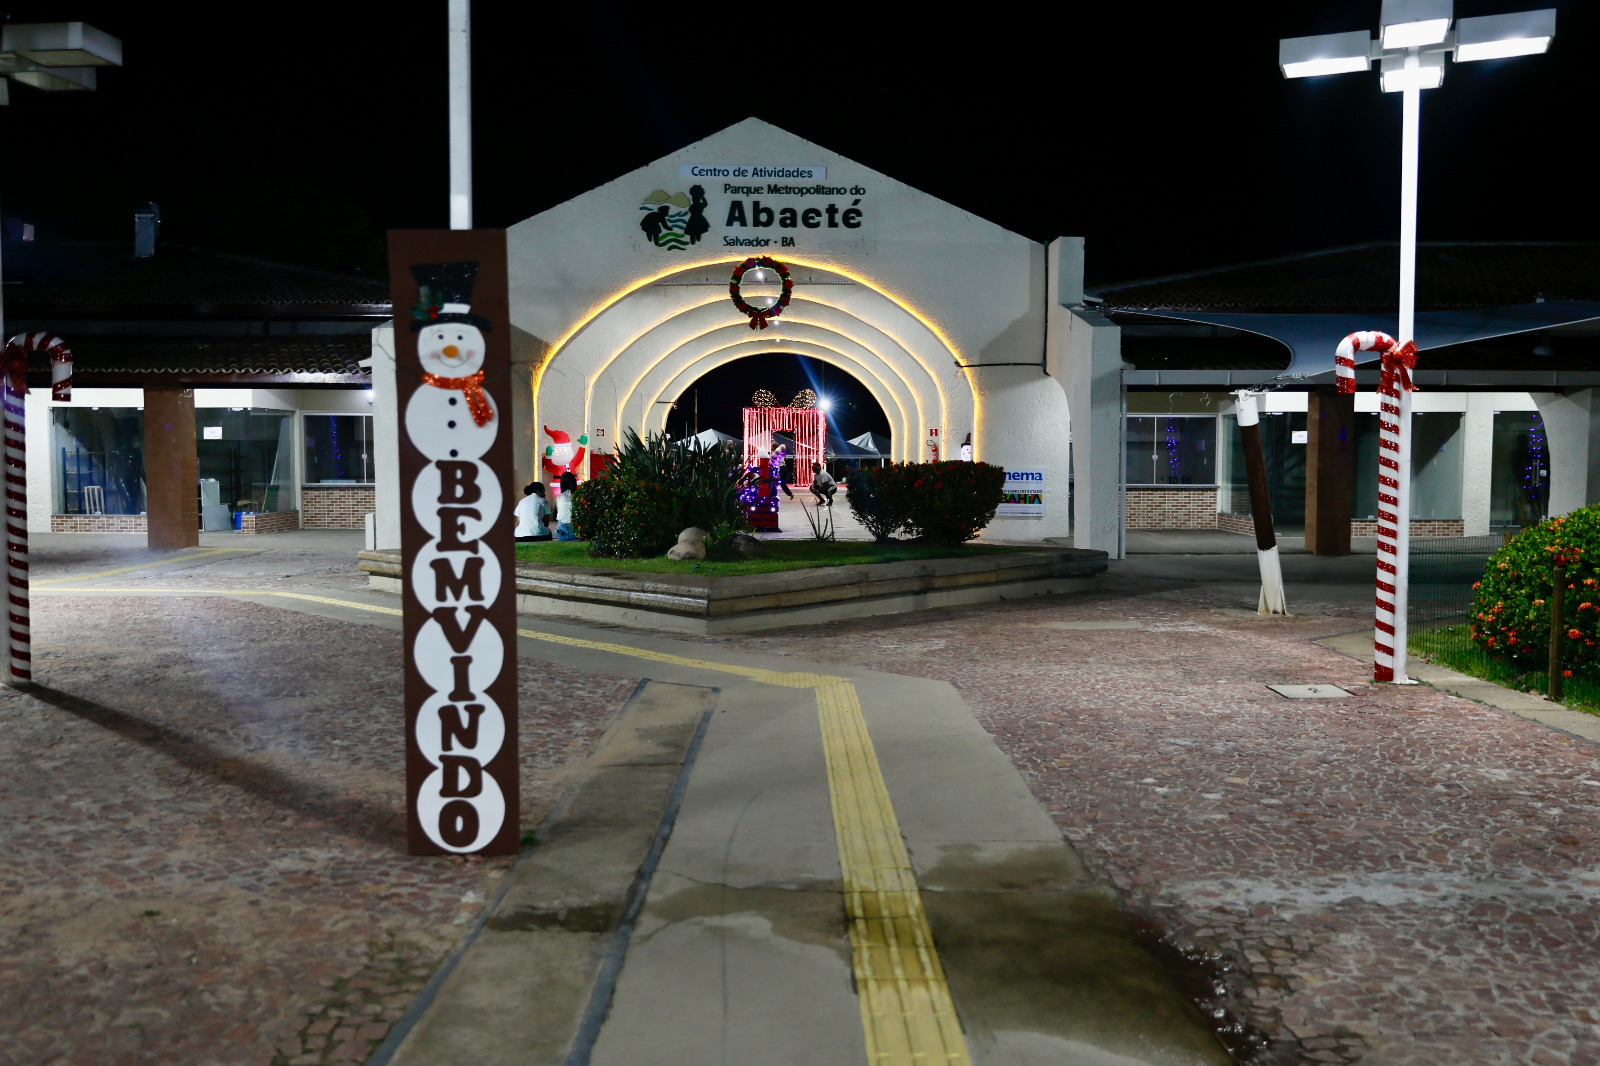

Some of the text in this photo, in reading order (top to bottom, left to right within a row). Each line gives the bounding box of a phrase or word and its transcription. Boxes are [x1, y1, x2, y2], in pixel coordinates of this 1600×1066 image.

[691, 166, 813, 178] Centro de Atividades
[724, 184, 866, 197] Parque Metropolitano do
[725, 199, 863, 229] Abaeté
[723, 236, 771, 247] Salvador
[781, 237, 795, 247] BA
[1004, 472, 1043, 481] nema
